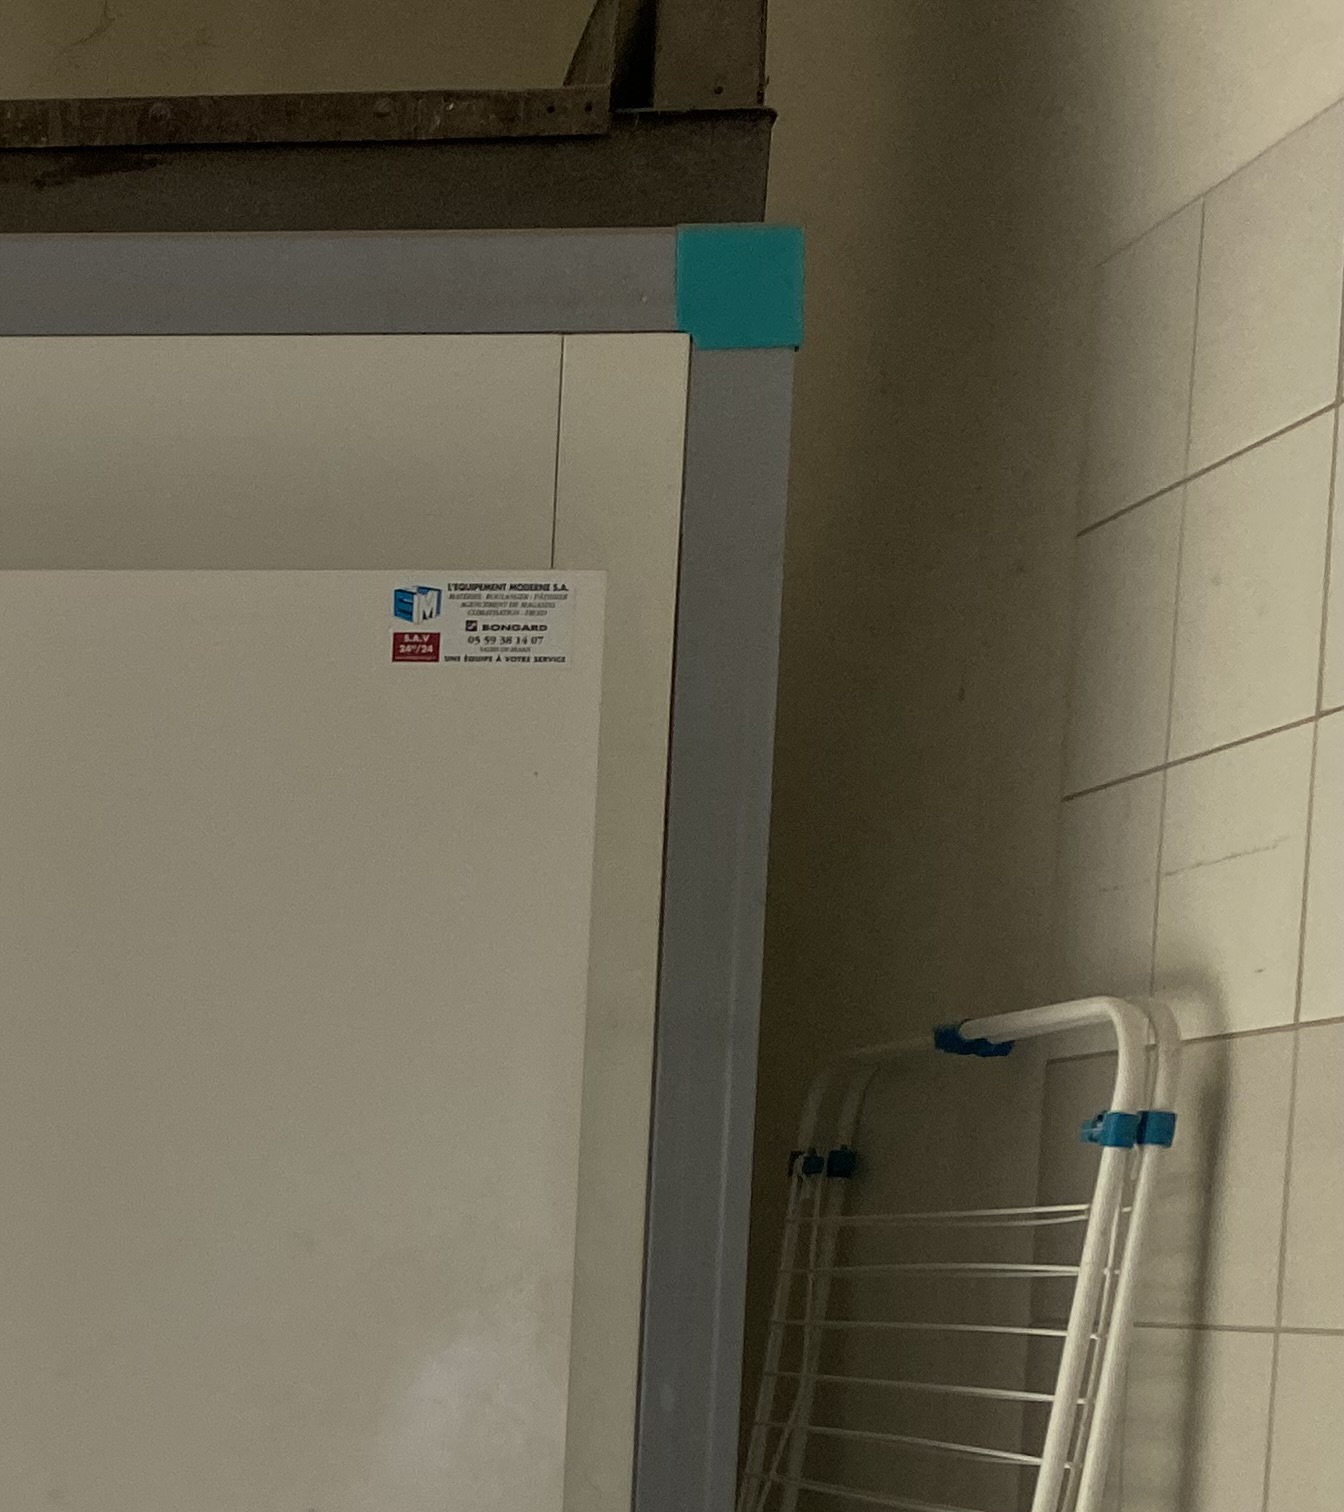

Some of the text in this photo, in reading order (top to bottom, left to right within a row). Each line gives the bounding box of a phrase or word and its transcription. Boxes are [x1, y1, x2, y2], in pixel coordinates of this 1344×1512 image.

[509, 583, 551, 592] MODERNE
[482, 624, 548, 632] BONGARD
[468, 636, 544, 645] 05 59 38 14 07
